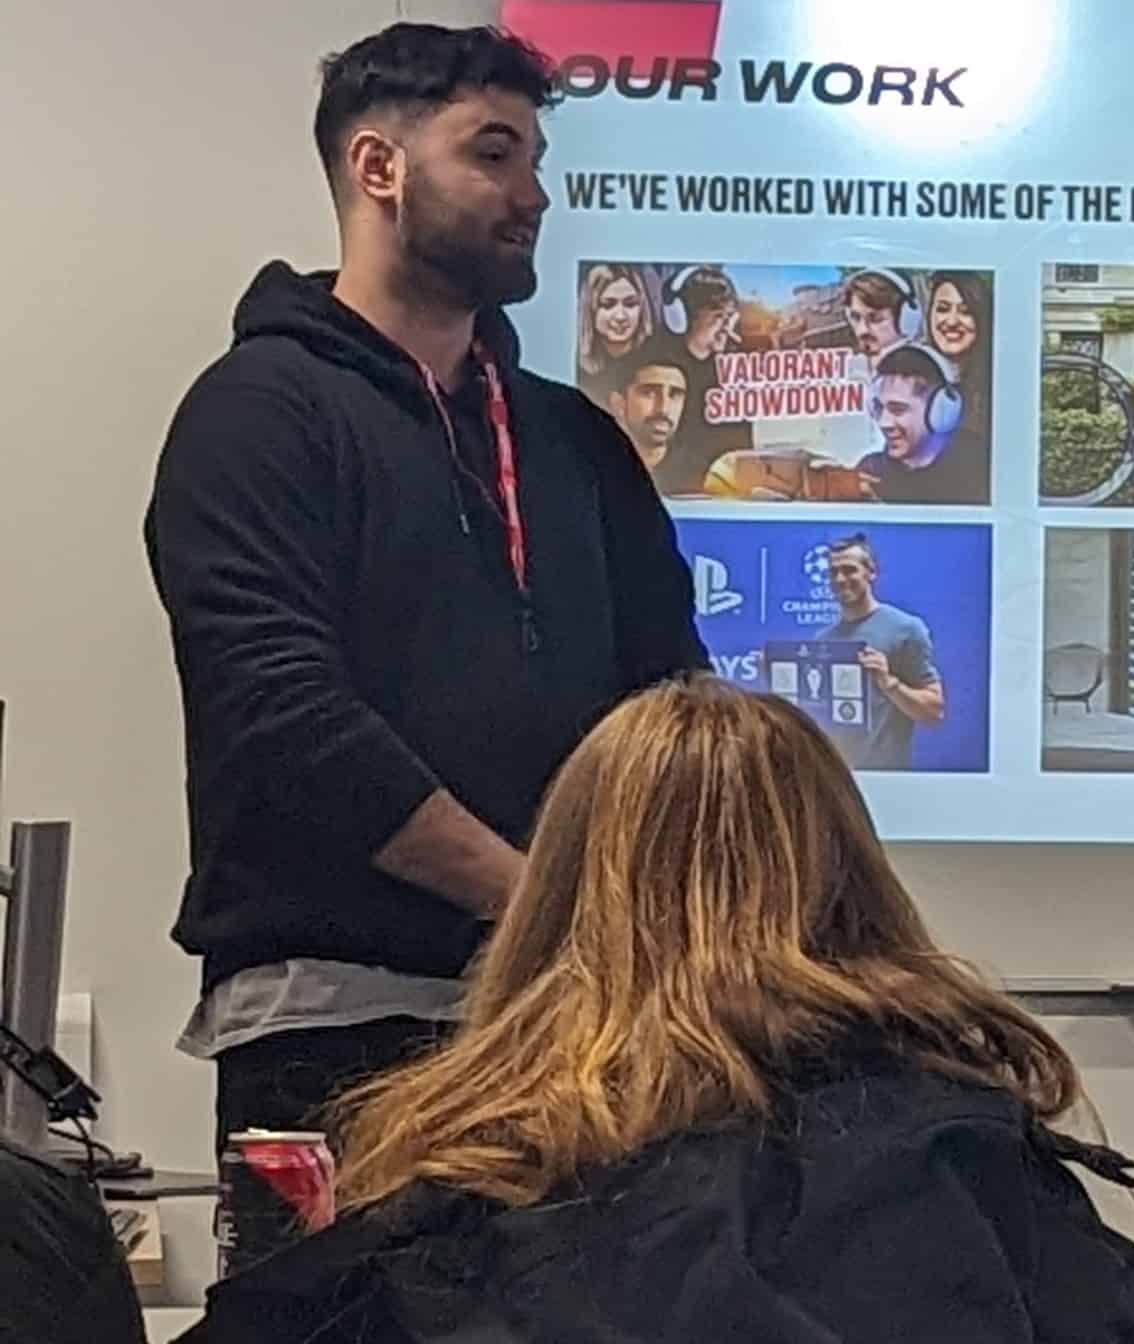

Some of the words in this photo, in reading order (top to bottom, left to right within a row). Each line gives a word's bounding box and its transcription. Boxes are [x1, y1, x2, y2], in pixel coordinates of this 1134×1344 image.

[559, 54, 723, 102] OUR
[738, 59, 969, 108] WORK
[564, 171, 669, 211] WE'VE
[675, 174, 814, 215] WORKED
[823, 178, 908, 218] WITH
[916, 181, 1007, 220] SOME
[1013, 183, 1055, 221] OF
[1061, 185, 1123, 223] THE
[718, 349, 850, 385] VALORANT
[707, 383, 866, 420] SHOWDOWN
